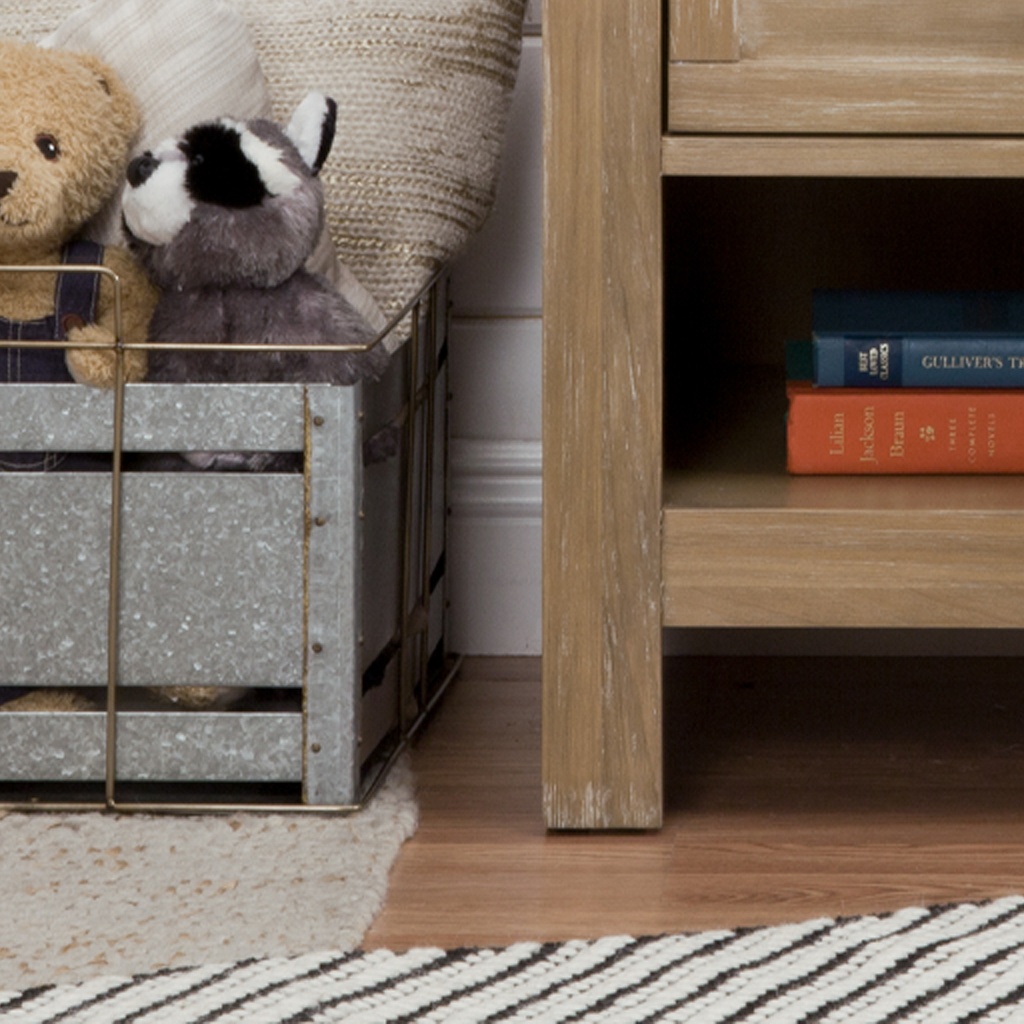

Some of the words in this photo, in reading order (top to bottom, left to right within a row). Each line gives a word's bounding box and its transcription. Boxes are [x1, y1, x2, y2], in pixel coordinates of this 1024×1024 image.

[879, 343, 890, 380] CLASSICS
[921, 355, 1004, 370] GULLIVER'S
[829, 412, 844, 455] Lilian
[859, 406, 878, 465] Jackson
[890, 411, 905, 457] Braun
[948, 418, 957, 452] THREE
[967, 406, 977, 464] COMPLETE
[987, 412, 996, 457] NOVELS
